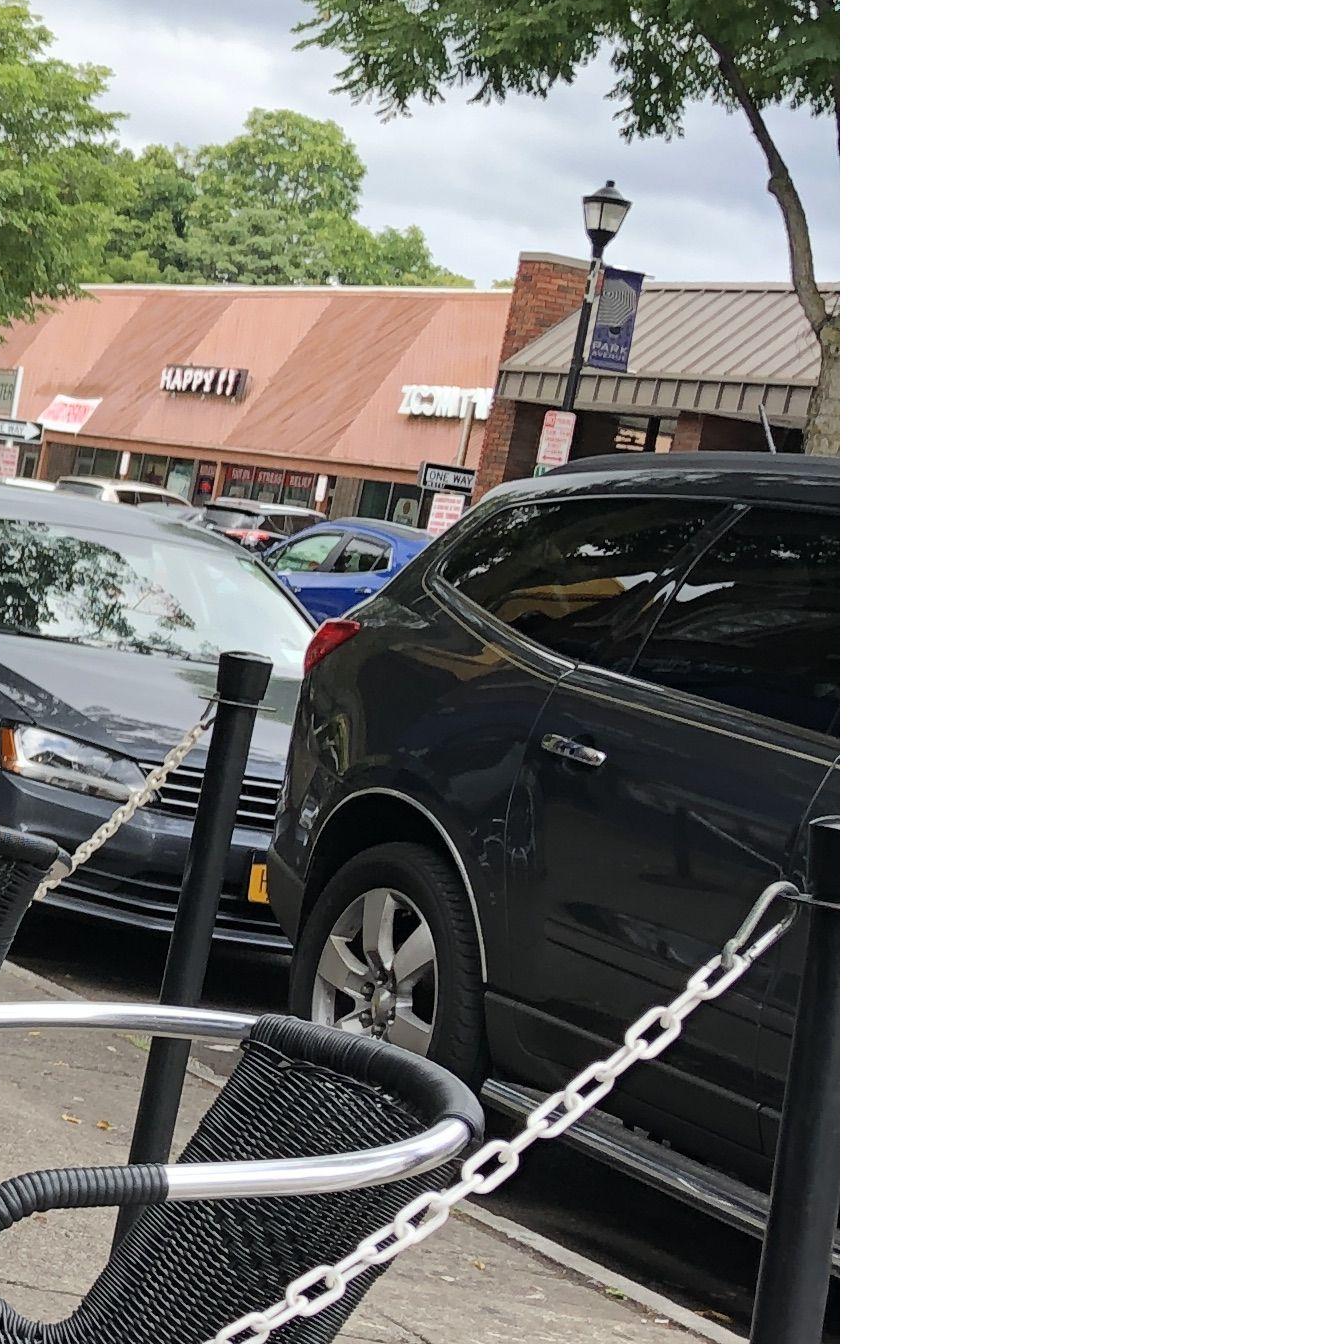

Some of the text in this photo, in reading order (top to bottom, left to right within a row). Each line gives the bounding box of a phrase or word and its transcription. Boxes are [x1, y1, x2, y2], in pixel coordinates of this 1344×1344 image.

[592, 340, 629, 355] PARK
[8, 423, 25, 435] WAY
[429, 469, 475, 489] ONE WAY
